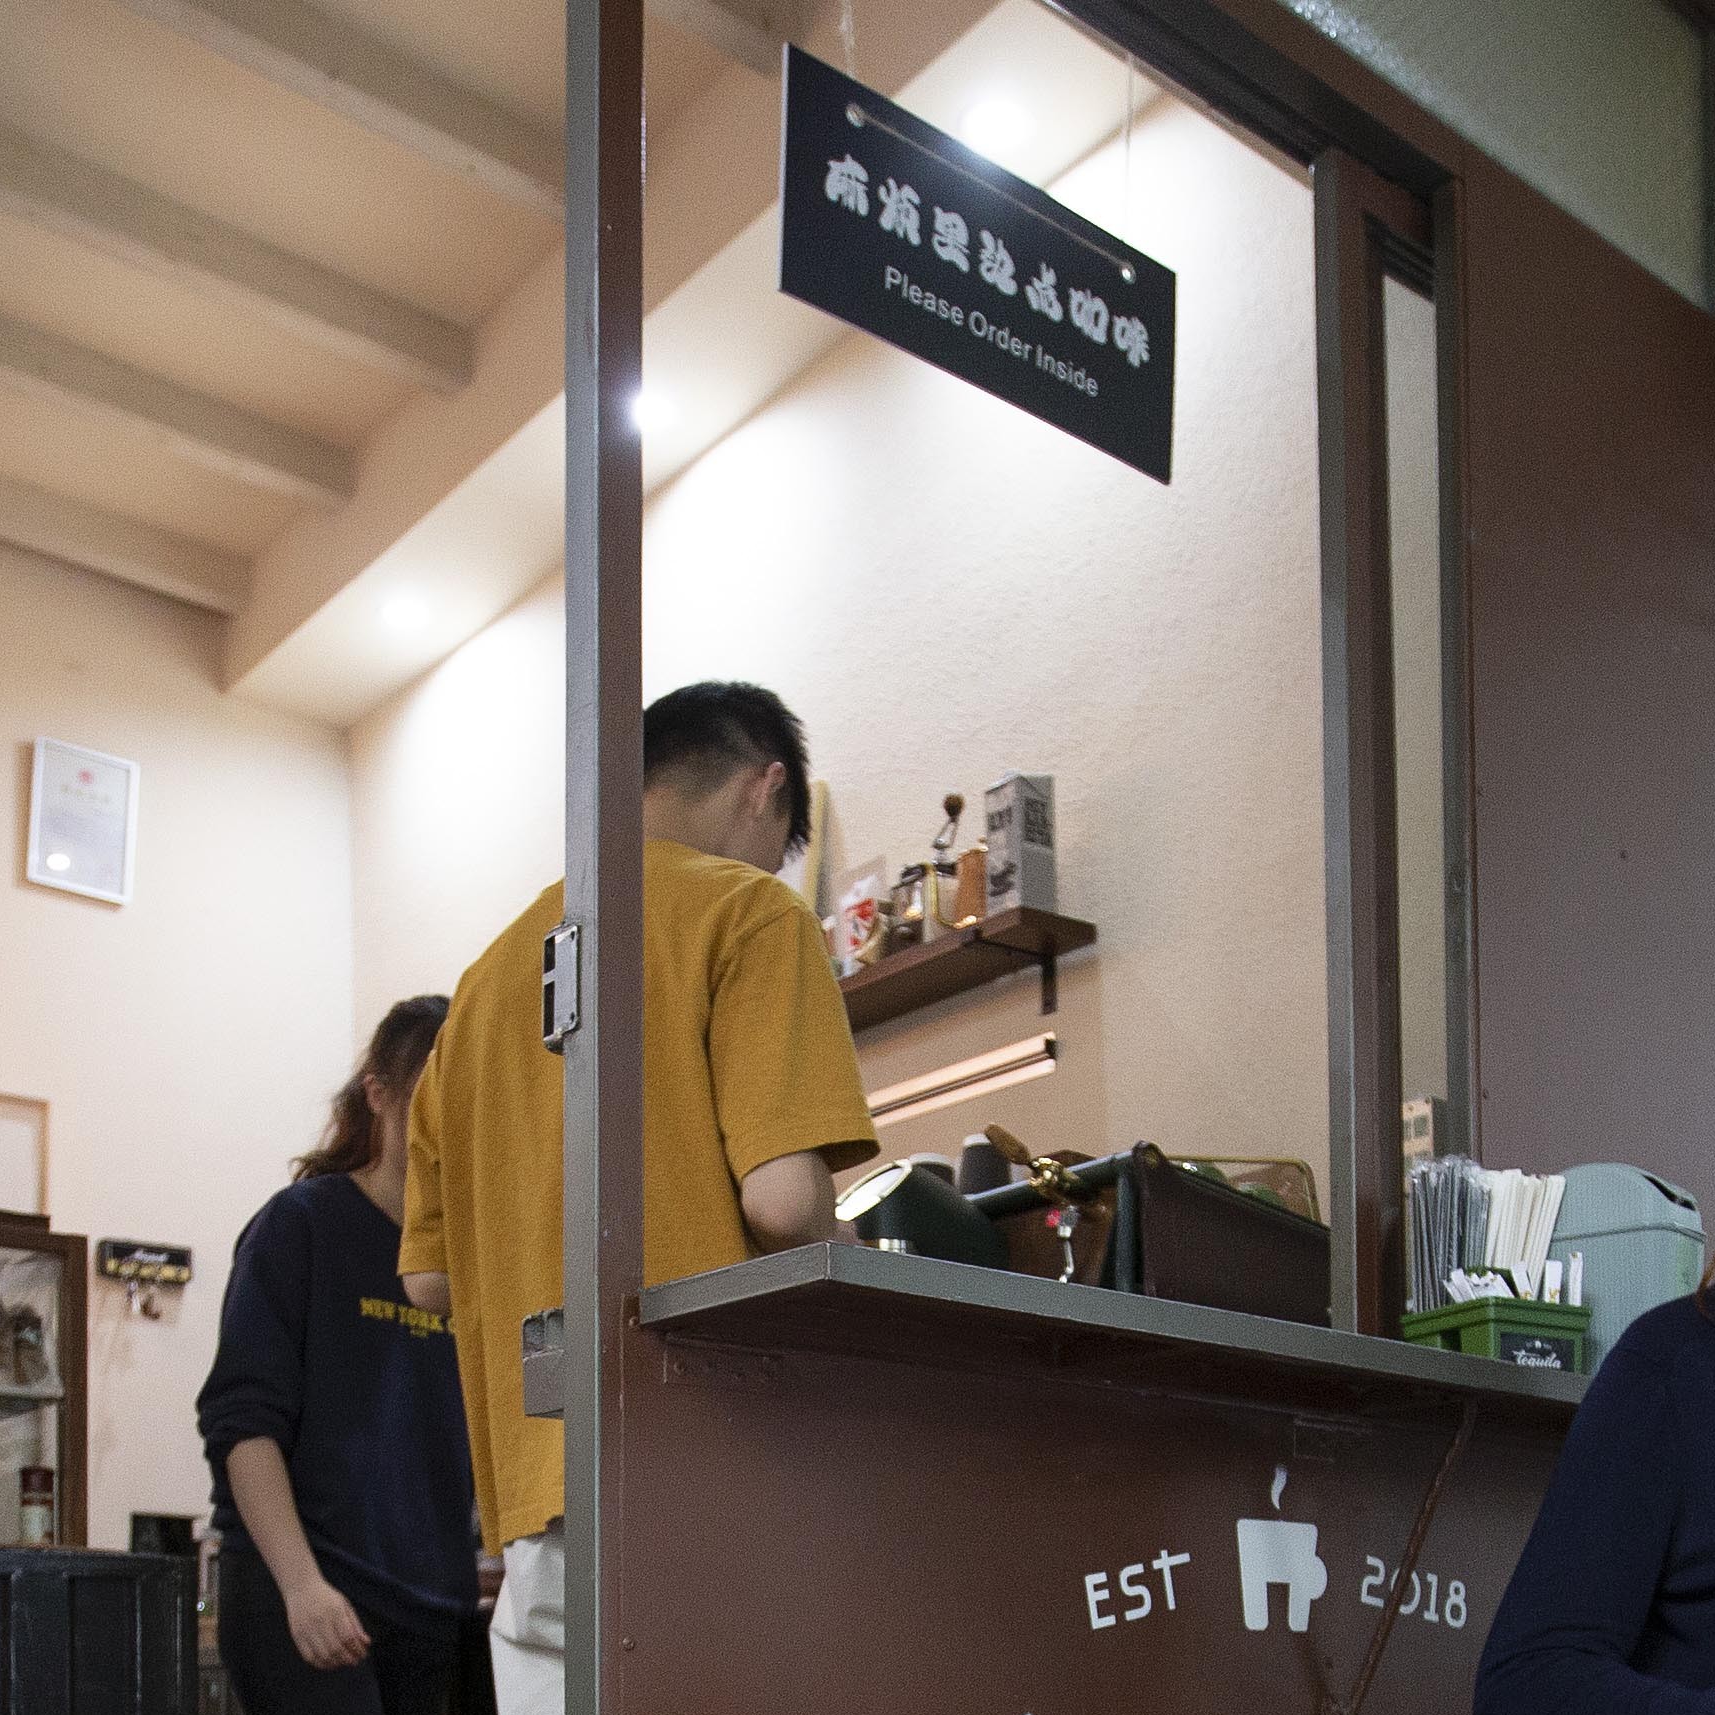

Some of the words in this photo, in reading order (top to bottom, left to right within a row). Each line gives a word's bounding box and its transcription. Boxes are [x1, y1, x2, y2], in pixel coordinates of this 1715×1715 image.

[884, 266, 964, 327] Please
[968, 311, 1031, 362] Order
[1037, 344, 1099, 398] Inside
[1084, 1548, 1190, 1630] EST
[1361, 1554, 1467, 1629] 2018
